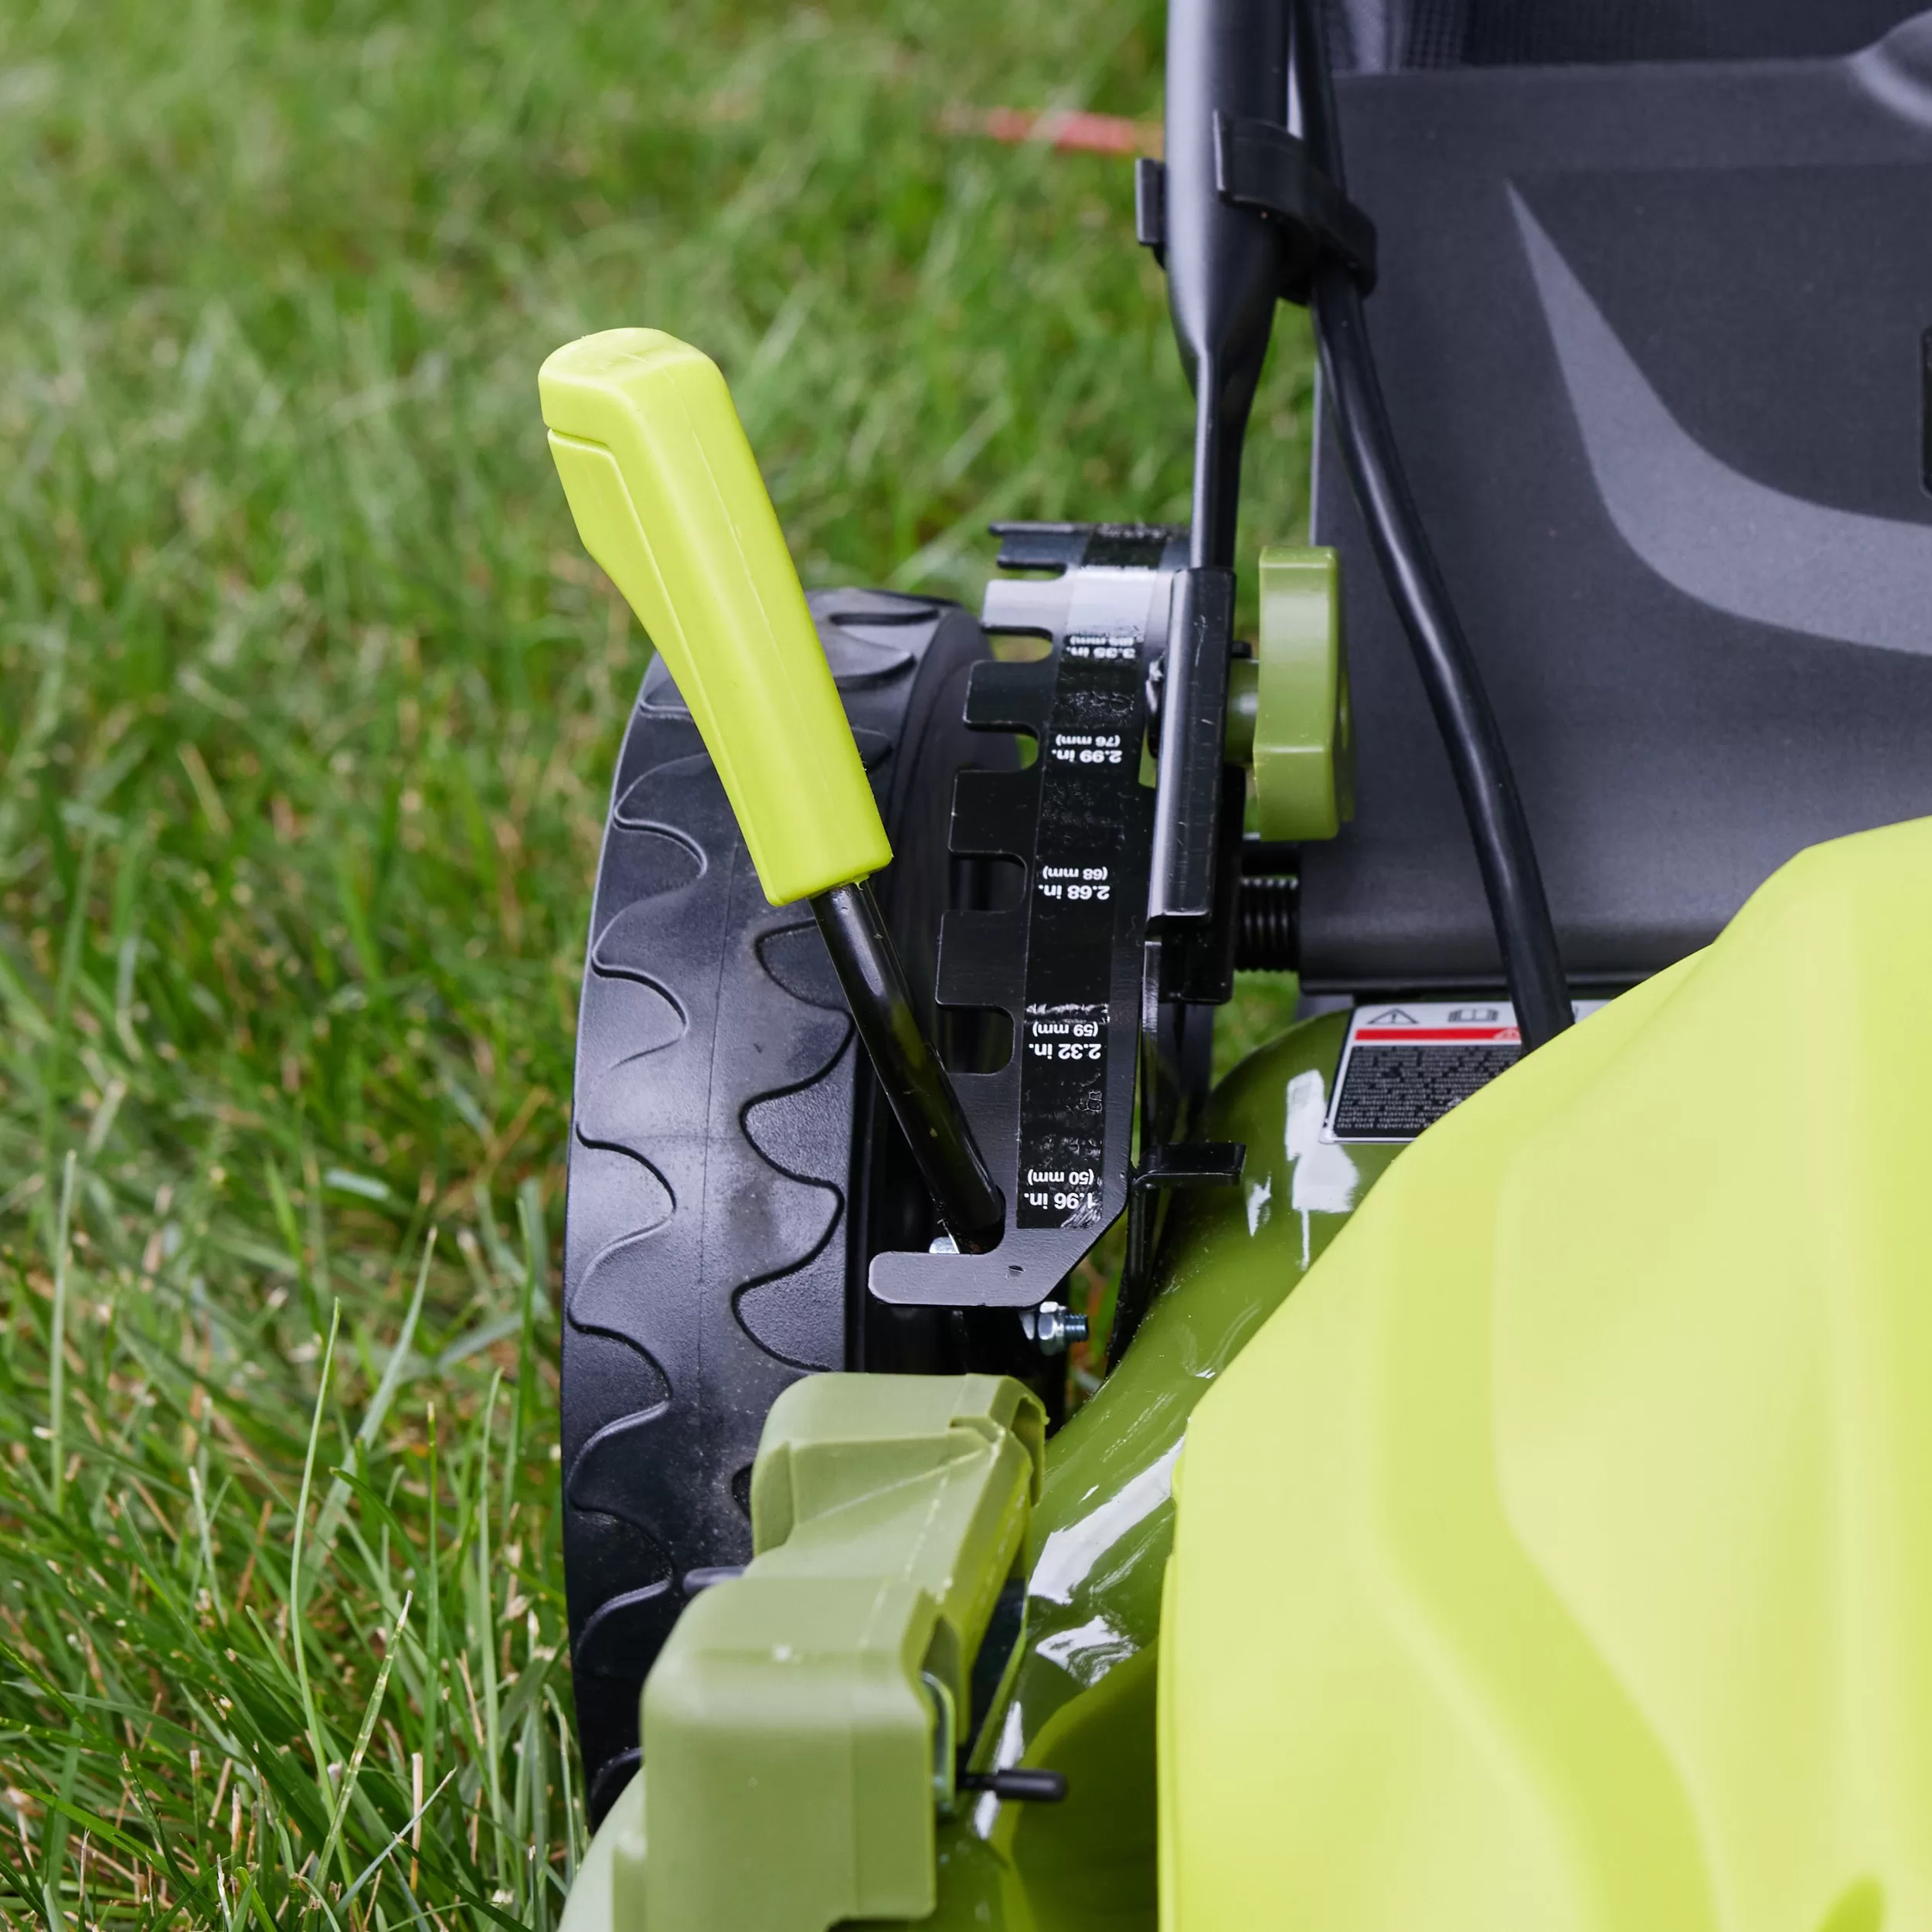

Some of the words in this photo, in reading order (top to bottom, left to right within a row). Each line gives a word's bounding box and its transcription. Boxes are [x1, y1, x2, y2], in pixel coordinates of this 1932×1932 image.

[1056, 733, 1091, 747] mm)
[1095, 733, 1121, 747] (76
[1052, 750, 1075, 764] in.
[1080, 750, 1122, 763] 2.99
[1043, 866, 1079, 880] mm)
[1083, 866, 1108, 880] (68
[1039, 885, 1063, 900] in.
[1068, 885, 1110, 900] 2.68
[1032, 1022, 1070, 1037] mm)
[1073, 1022, 1098, 1037] (59
[1029, 1043, 1053, 1059] in.
[1059, 1043, 1101, 1059] 2.32
[1028, 1169, 1066, 1185] mm)
[1069, 1168, 1094, 1185] (50
[1024, 1192, 1048, 1209] in.
[1053, 1192, 1095, 1209] 1.96
